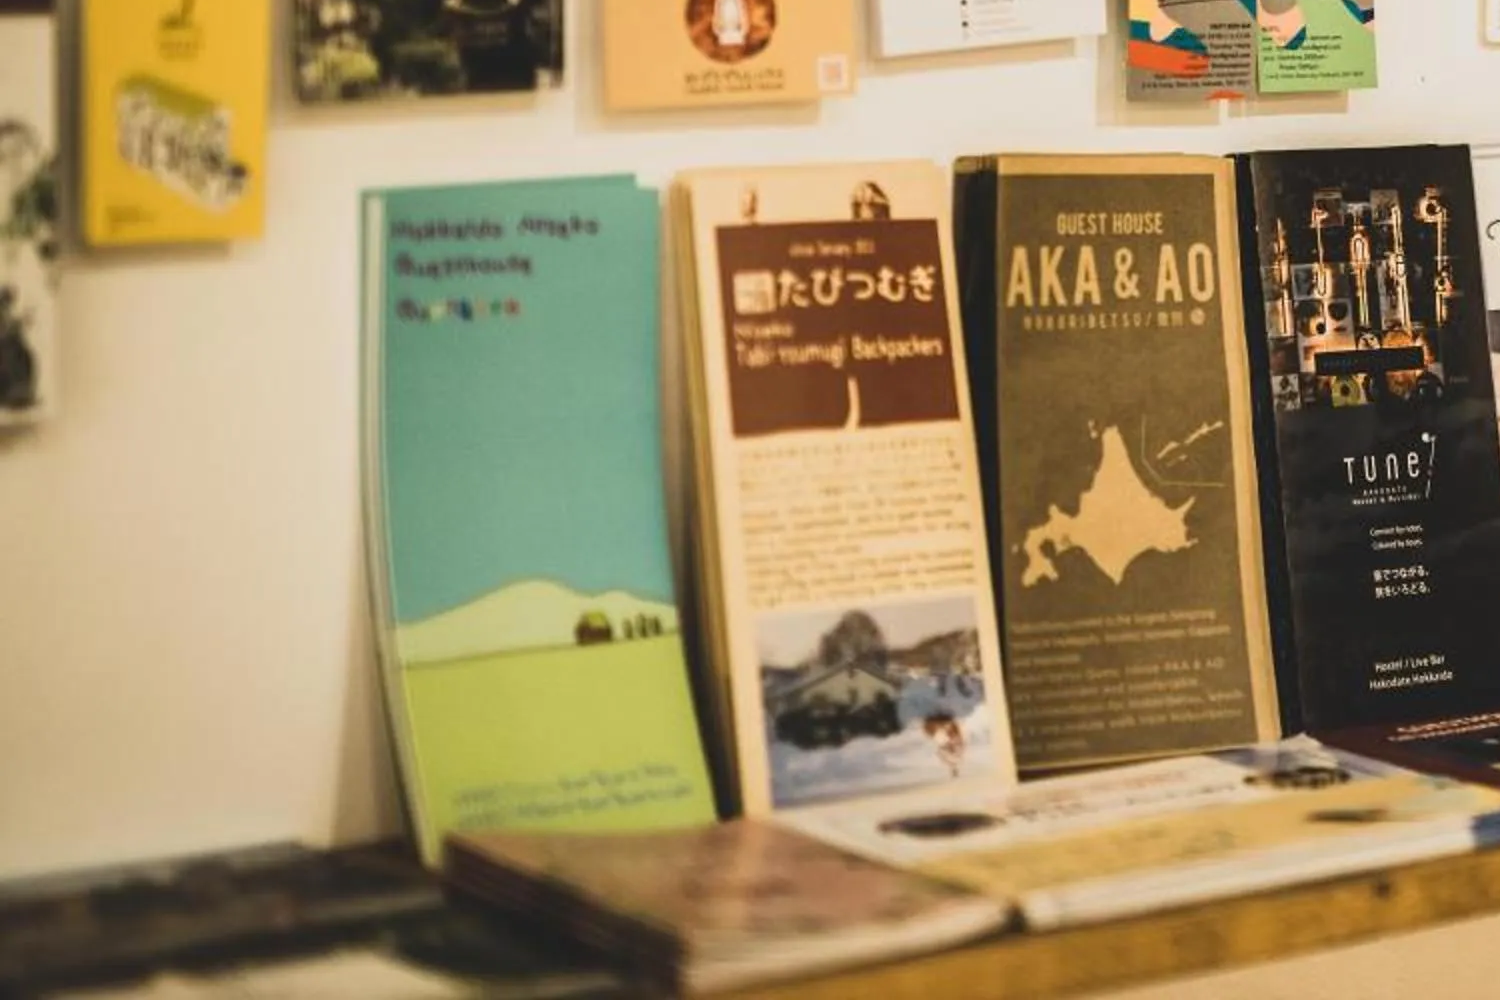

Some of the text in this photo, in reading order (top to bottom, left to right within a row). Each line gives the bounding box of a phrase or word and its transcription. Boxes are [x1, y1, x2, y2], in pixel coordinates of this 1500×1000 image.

[1056, 211, 1164, 235] GUEST HOUSE
[778, 264, 936, 308] たびつむぎ
[1006, 242, 1216, 308] AKA & AO
[1410, 656, 1429, 668] Live
[1430, 653, 1445, 665] Bar
